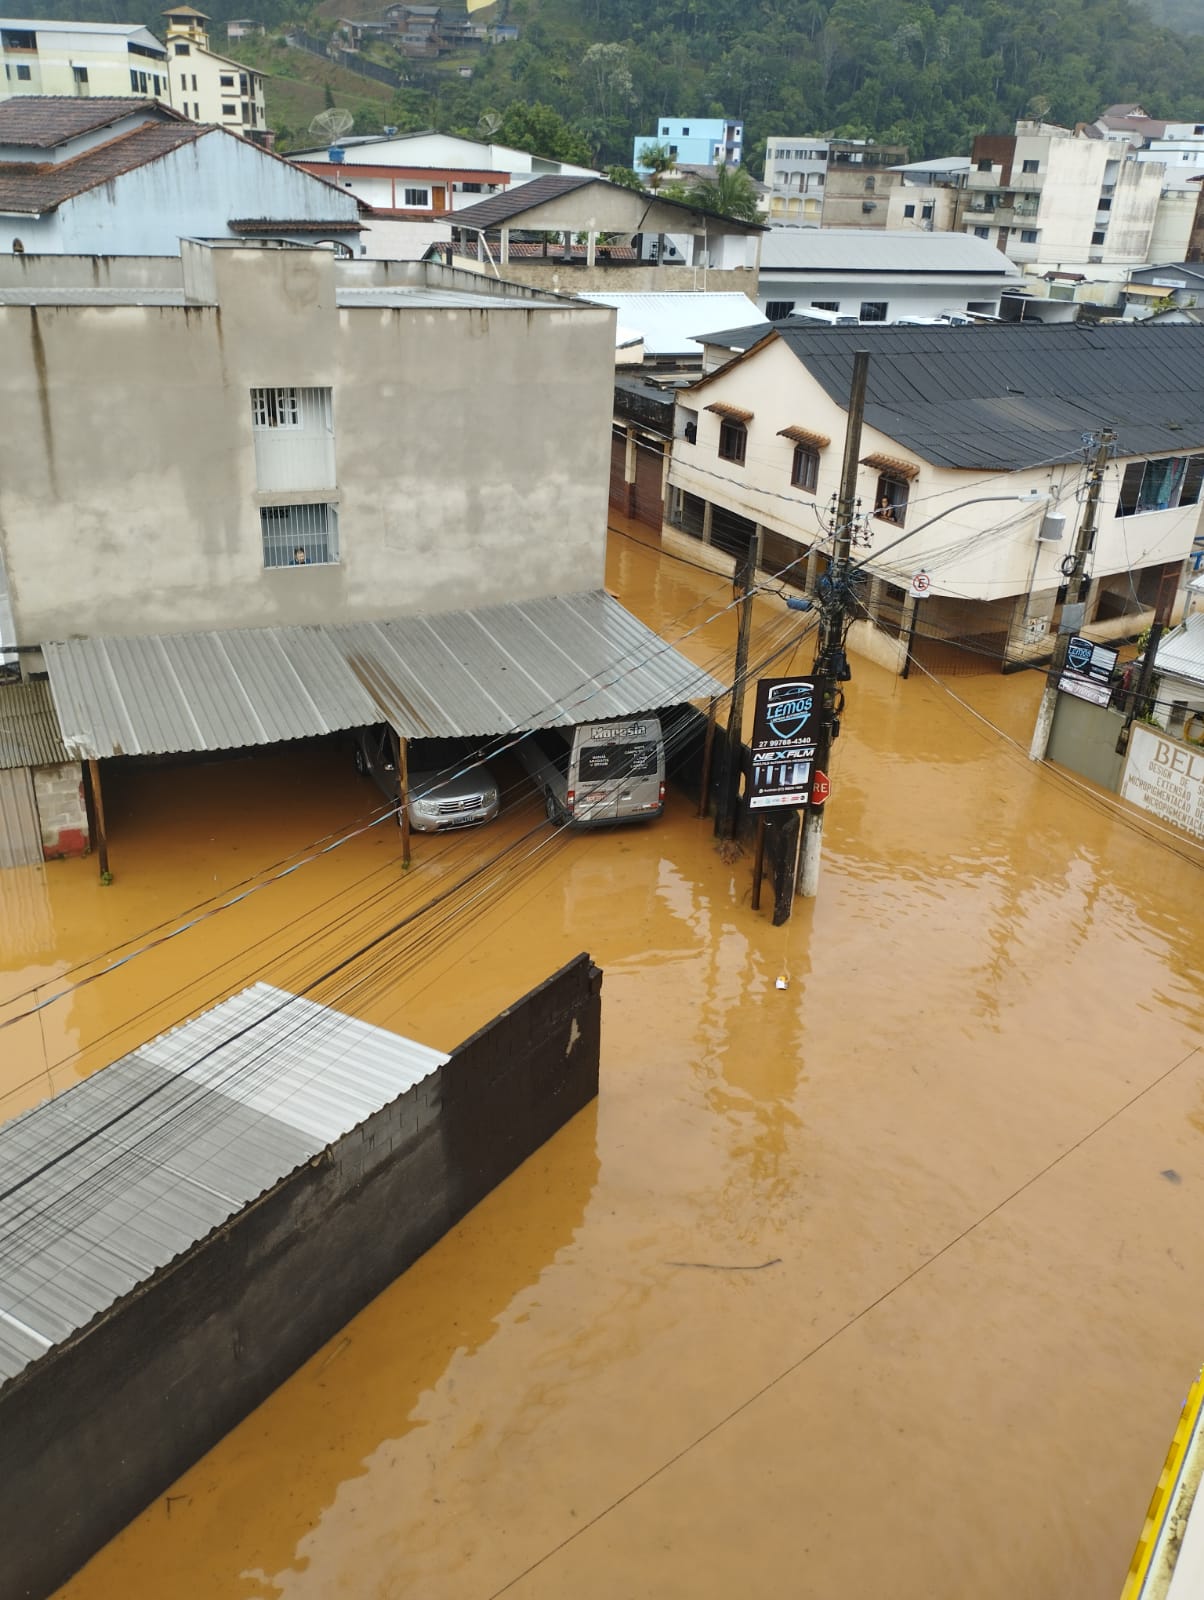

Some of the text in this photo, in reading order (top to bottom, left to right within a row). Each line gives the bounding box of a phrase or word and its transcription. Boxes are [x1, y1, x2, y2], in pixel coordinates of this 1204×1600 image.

[766, 697, 813, 720] LEMOS
[759, 740, 768, 748] 27
[1148, 760, 1173, 780] DESIGN
[1153, 740, 1204, 784] BEL
